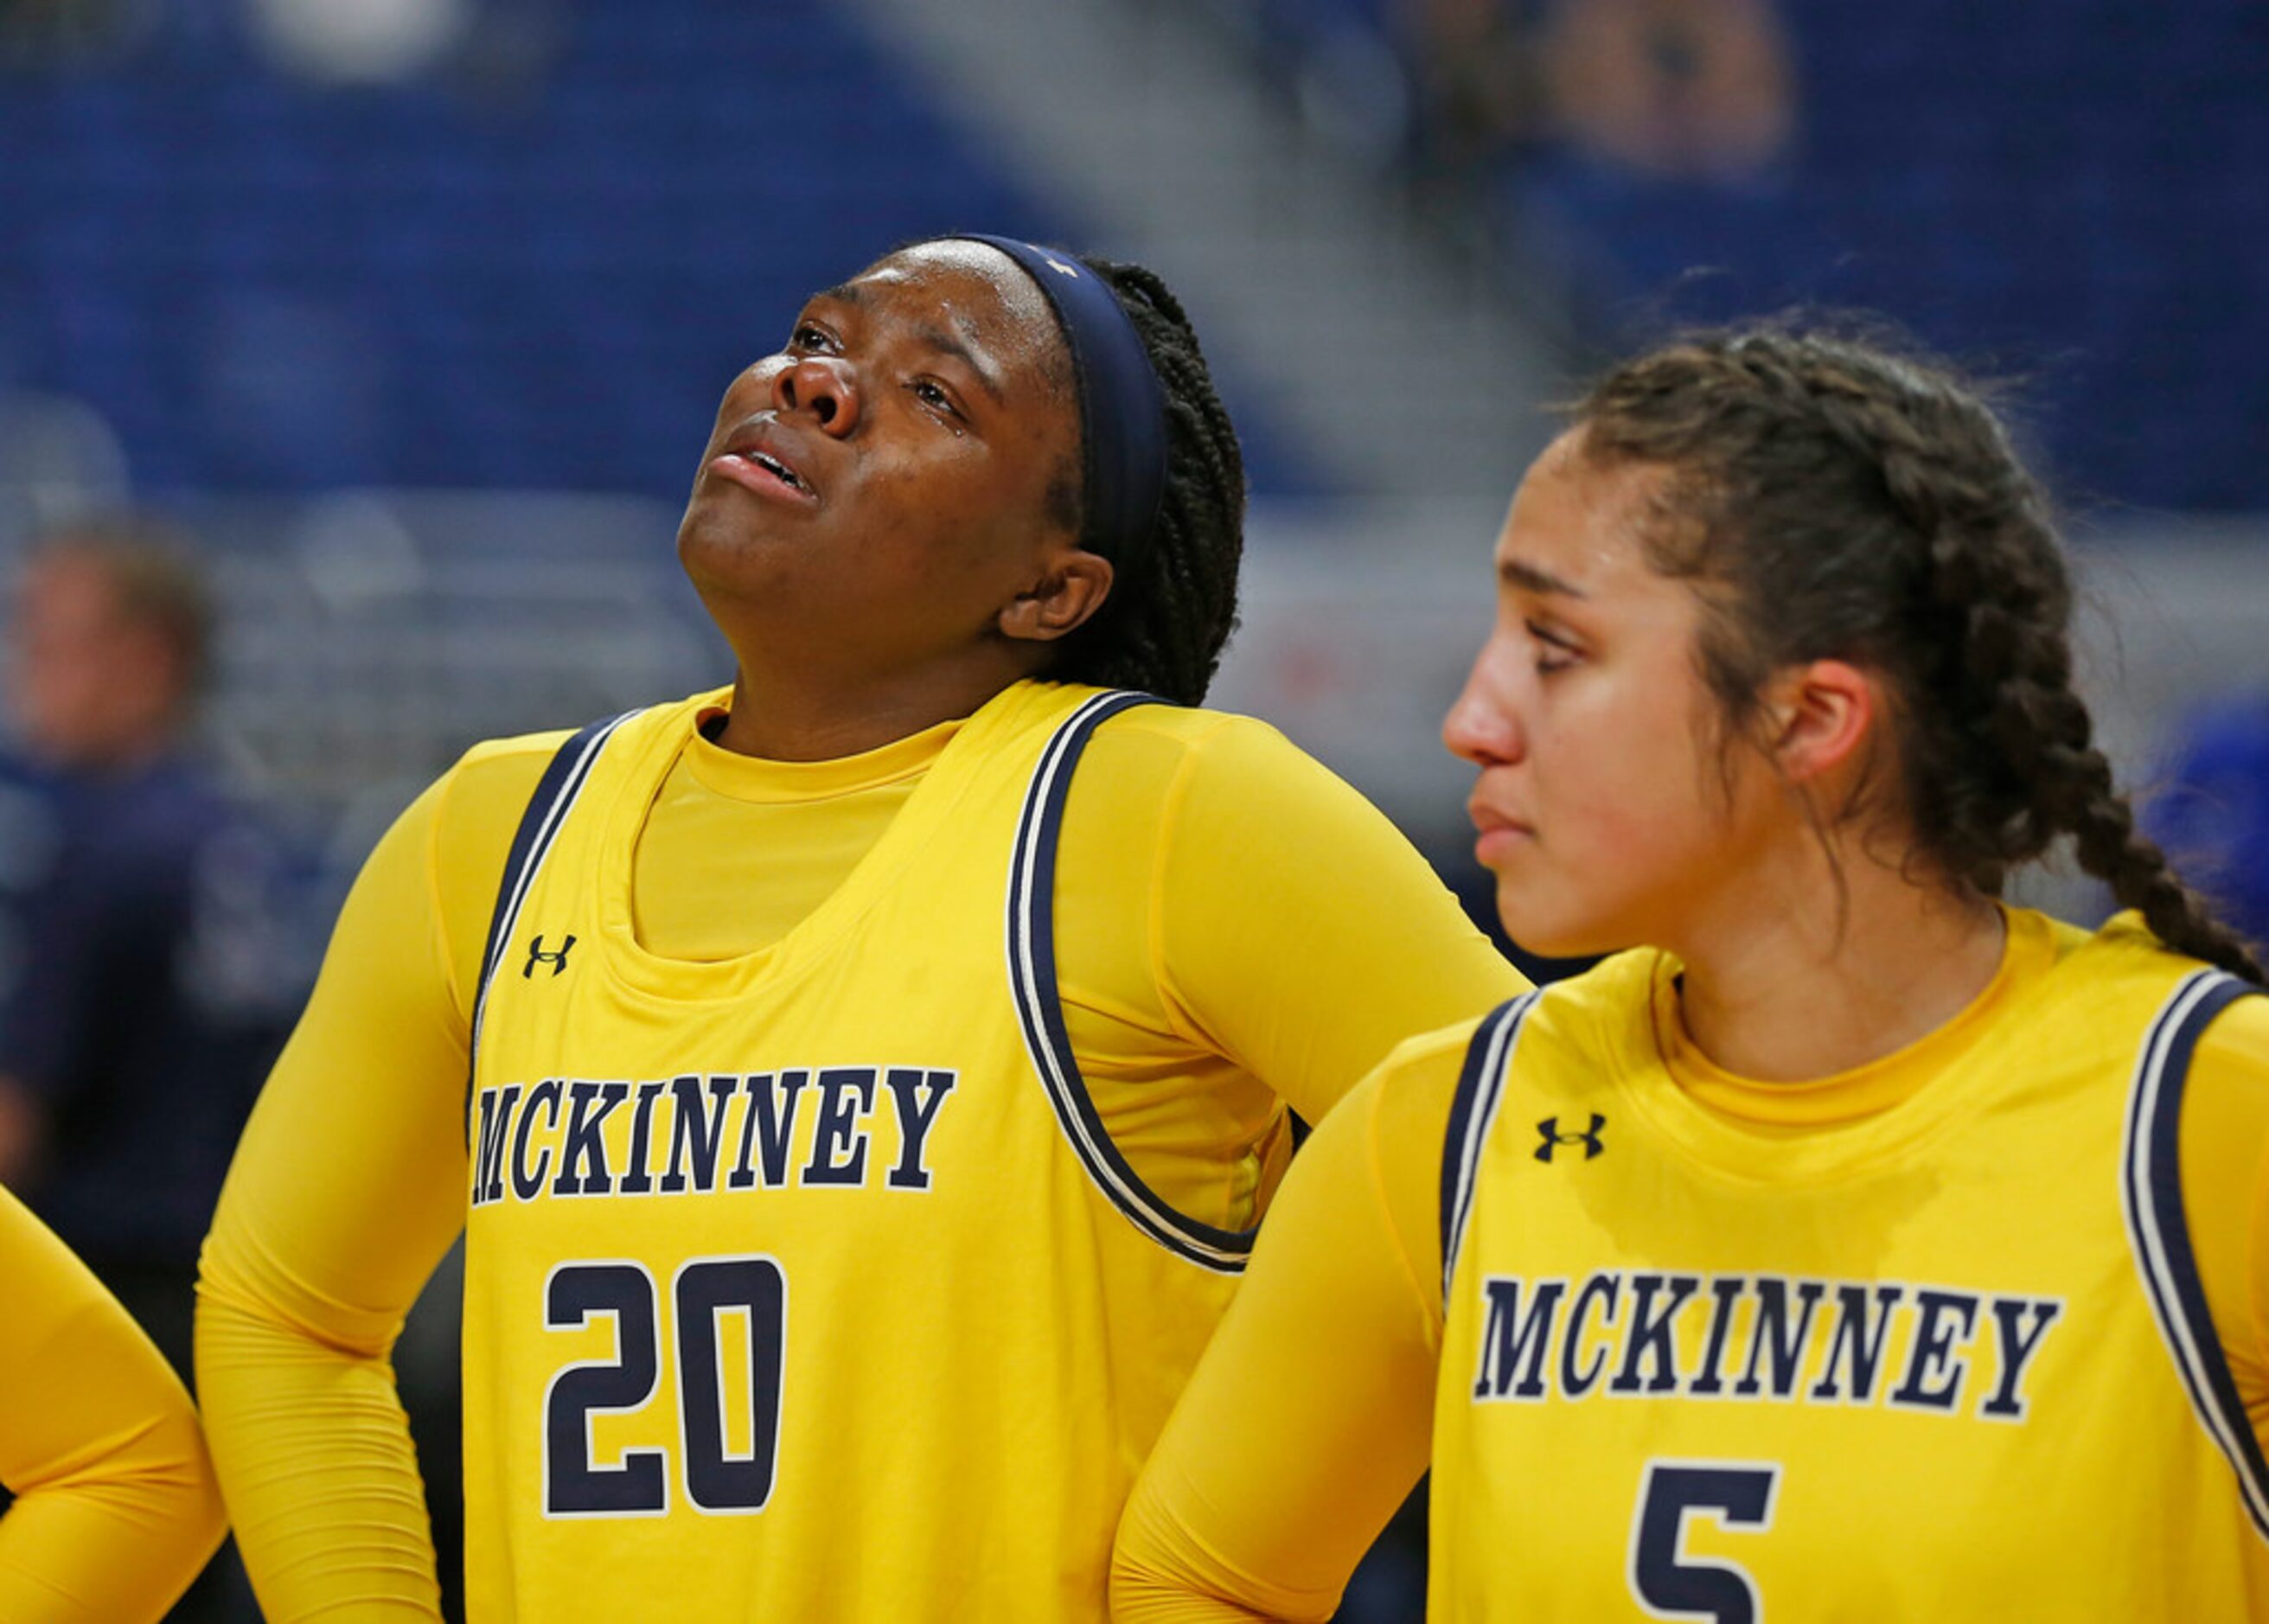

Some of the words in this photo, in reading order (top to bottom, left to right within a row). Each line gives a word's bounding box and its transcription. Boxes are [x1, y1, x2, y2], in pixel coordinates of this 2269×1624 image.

[471, 1066, 956, 1206] MCKINNEY
[542, 1253, 788, 1519] 20
[1472, 1271, 2065, 1423] MCKINNEY
[1627, 1458, 1781, 1624] 5
